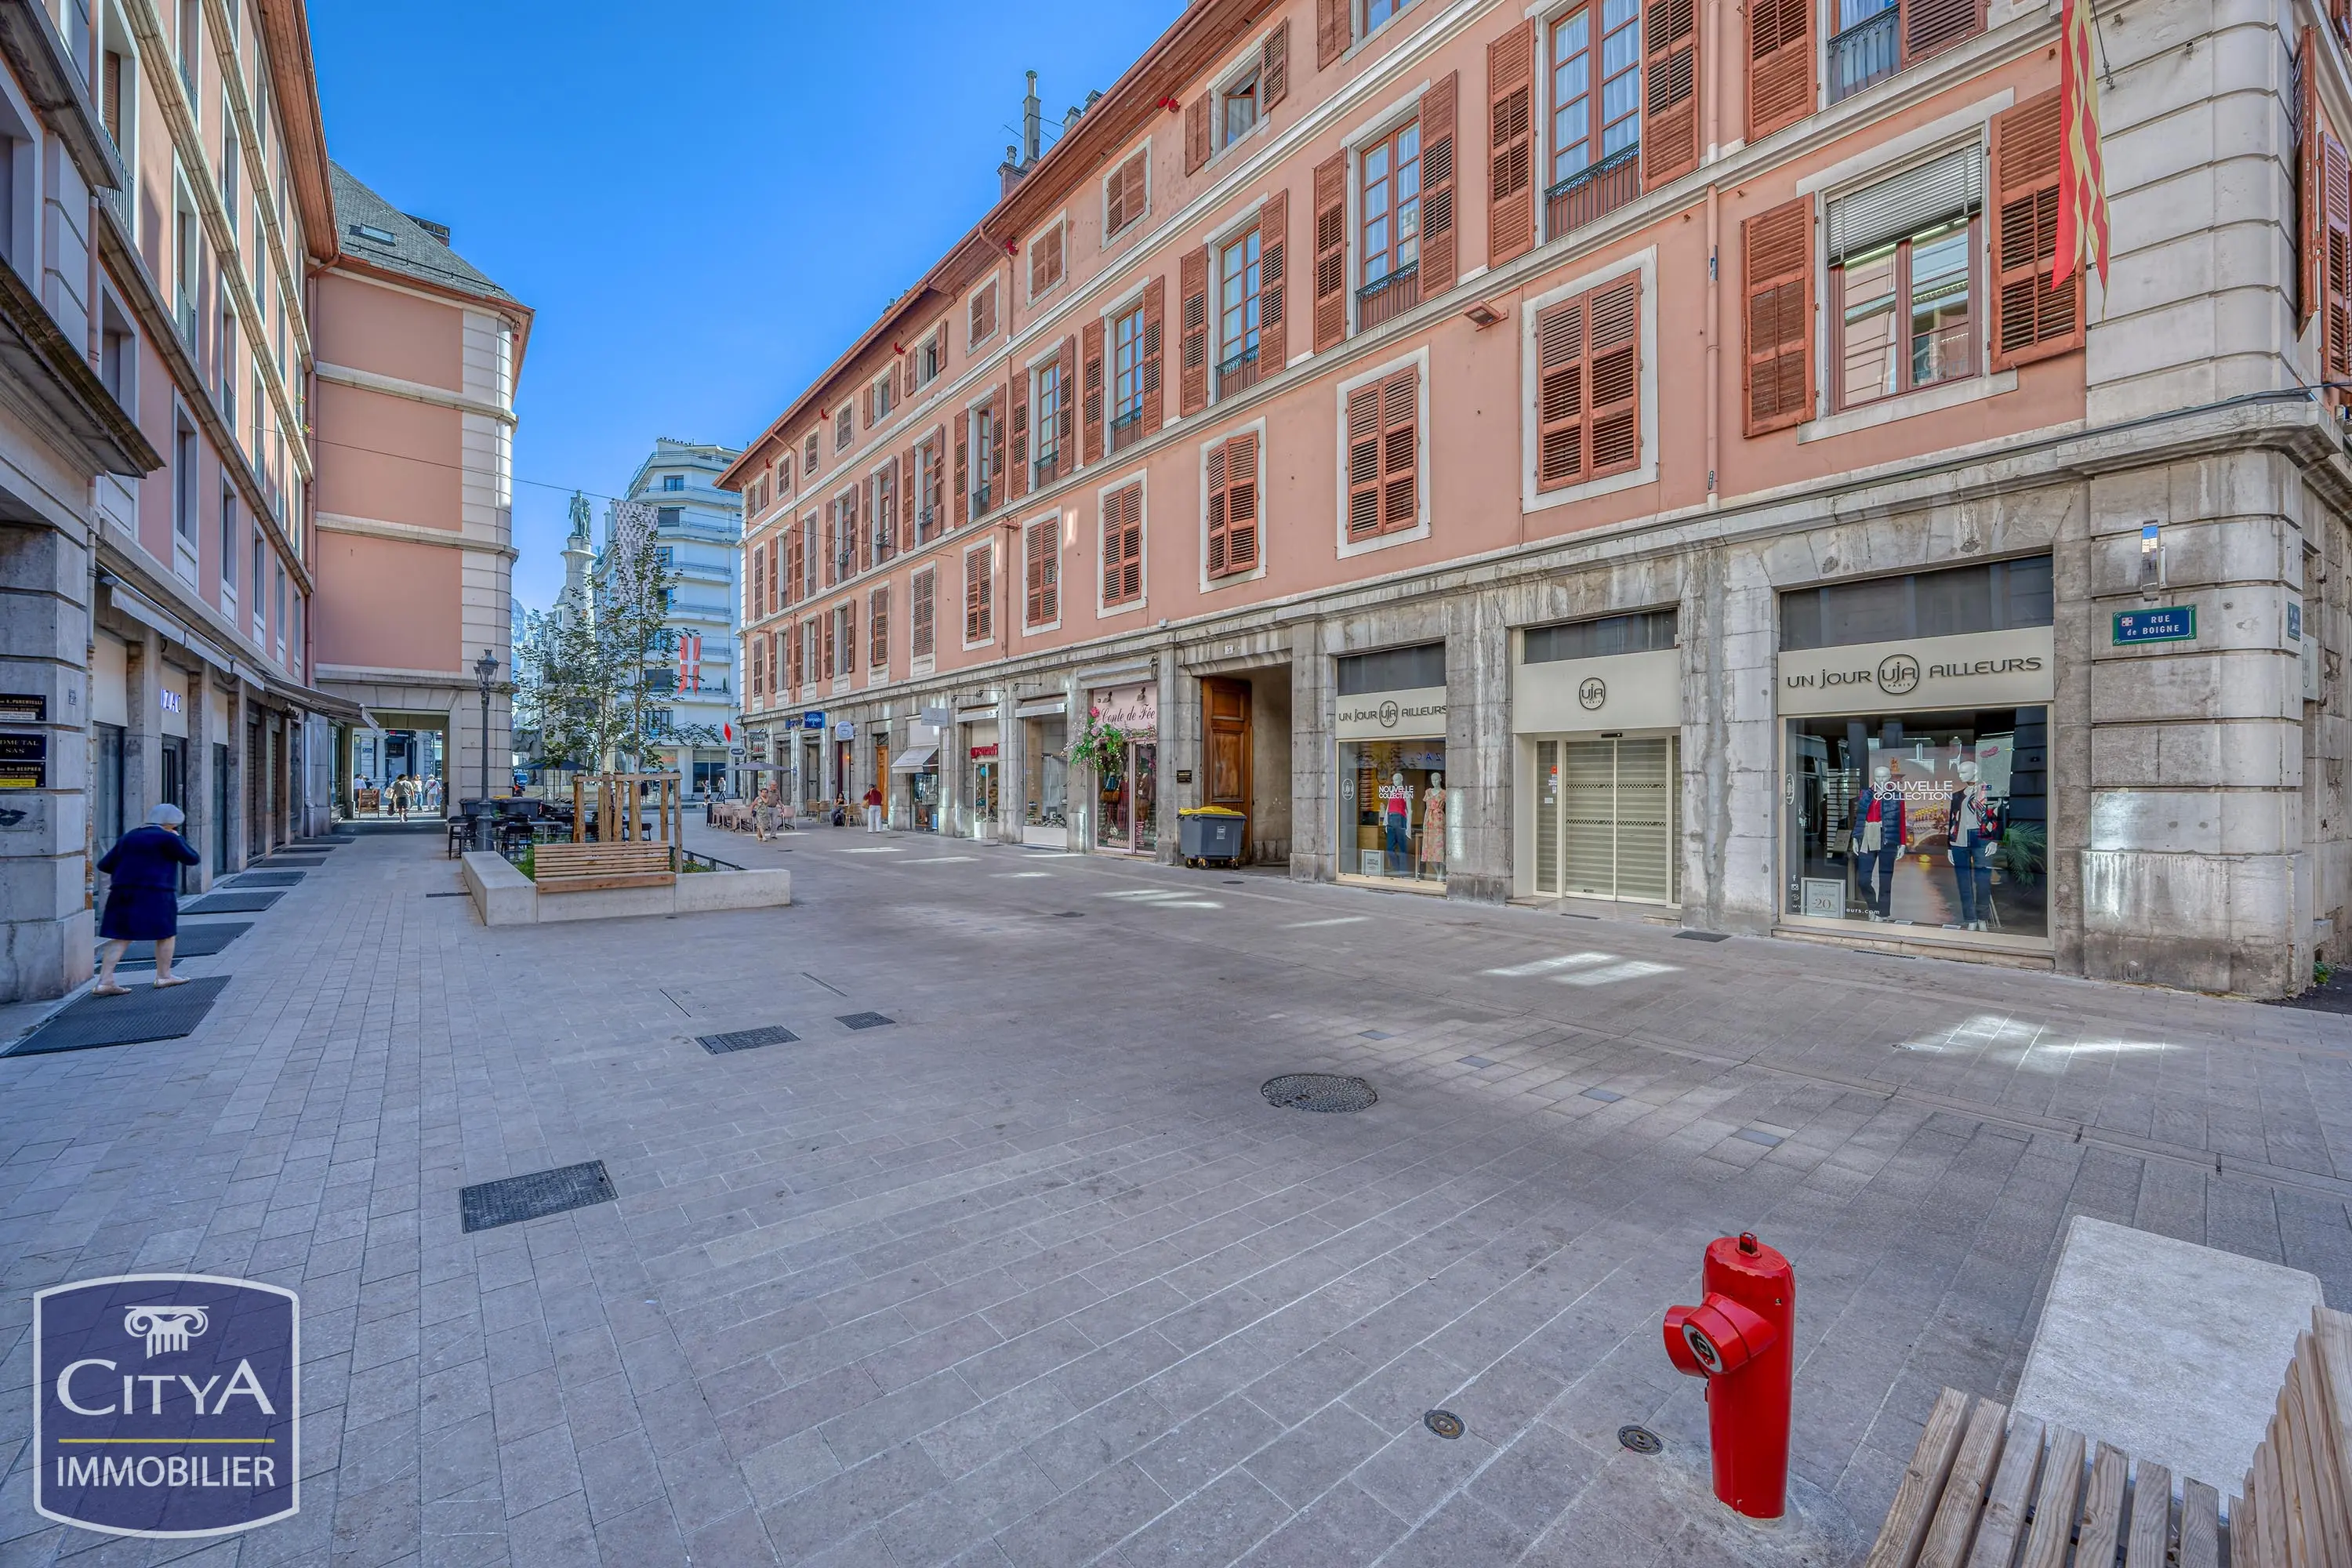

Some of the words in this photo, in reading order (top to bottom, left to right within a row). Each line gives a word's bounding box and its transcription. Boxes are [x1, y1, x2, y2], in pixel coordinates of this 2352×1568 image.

[2151, 615, 2170, 623] RUE
[2143, 625, 2180, 634] BOIGNE
[1788, 674, 1813, 688] UN
[1929, 657, 2042, 678] AILLEURS
[160, 688, 181, 713] IZAC
[1102, 708, 1124, 723] Conte
[1127, 706, 1137, 720] de
[1139, 704, 1156, 720] Fée
[1338, 713, 1352, 721] UN
[1402, 706, 1446, 717] AILLEURS
[1873, 780, 1953, 792] NOUVELLE
[1873, 792, 1953, 800] COLLECTION
